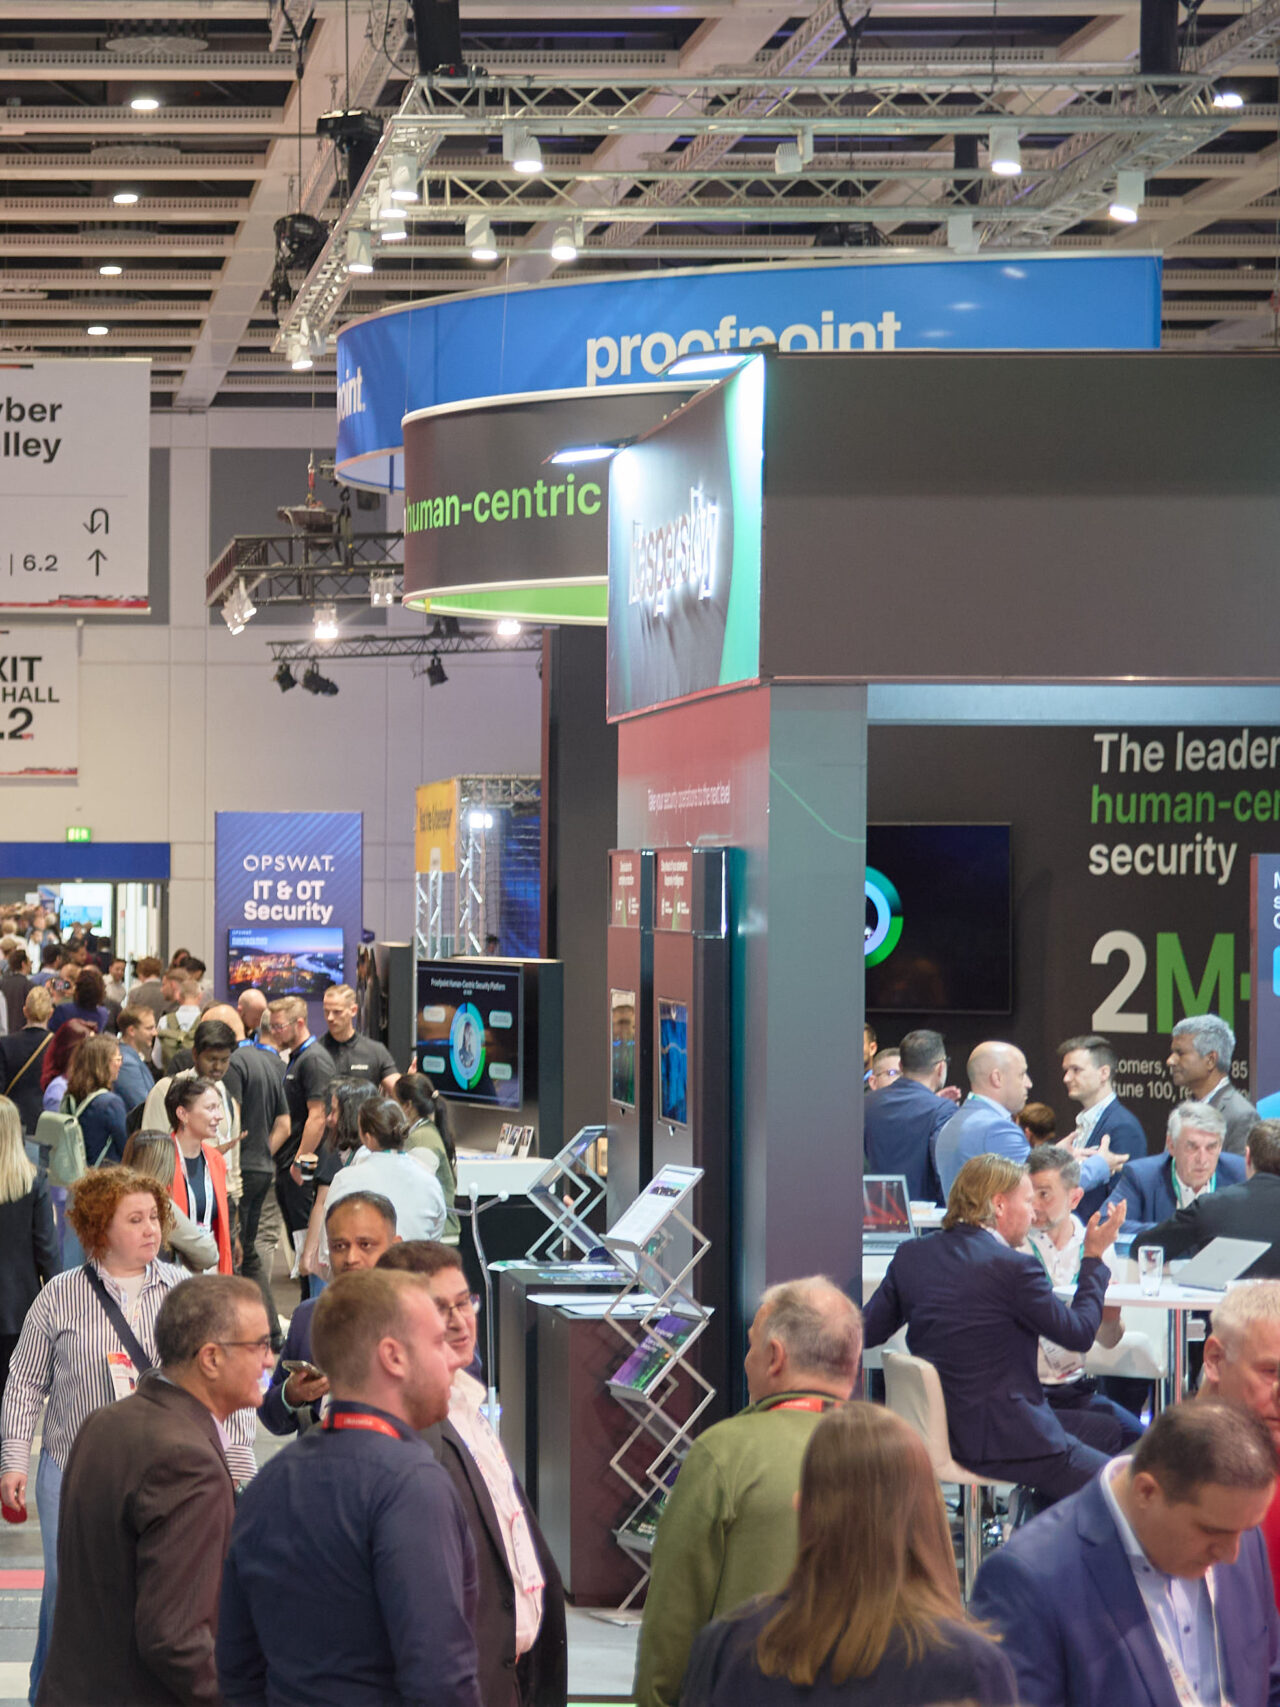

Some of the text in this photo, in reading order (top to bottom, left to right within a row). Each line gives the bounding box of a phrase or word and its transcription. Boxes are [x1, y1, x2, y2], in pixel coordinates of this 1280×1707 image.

[406, 473, 601, 536] human-centric
[23, 555, 58, 572] 6.2
[2, 686, 60, 703] HALL
[1094, 733, 1164, 773] The
[1089, 832, 1237, 885] security
[253, 880, 325, 900] IT & OT
[244, 901, 333, 925] Security
[1231, 1060, 1248, 1079] 85
[1147, 1081, 1176, 1102] 100,
